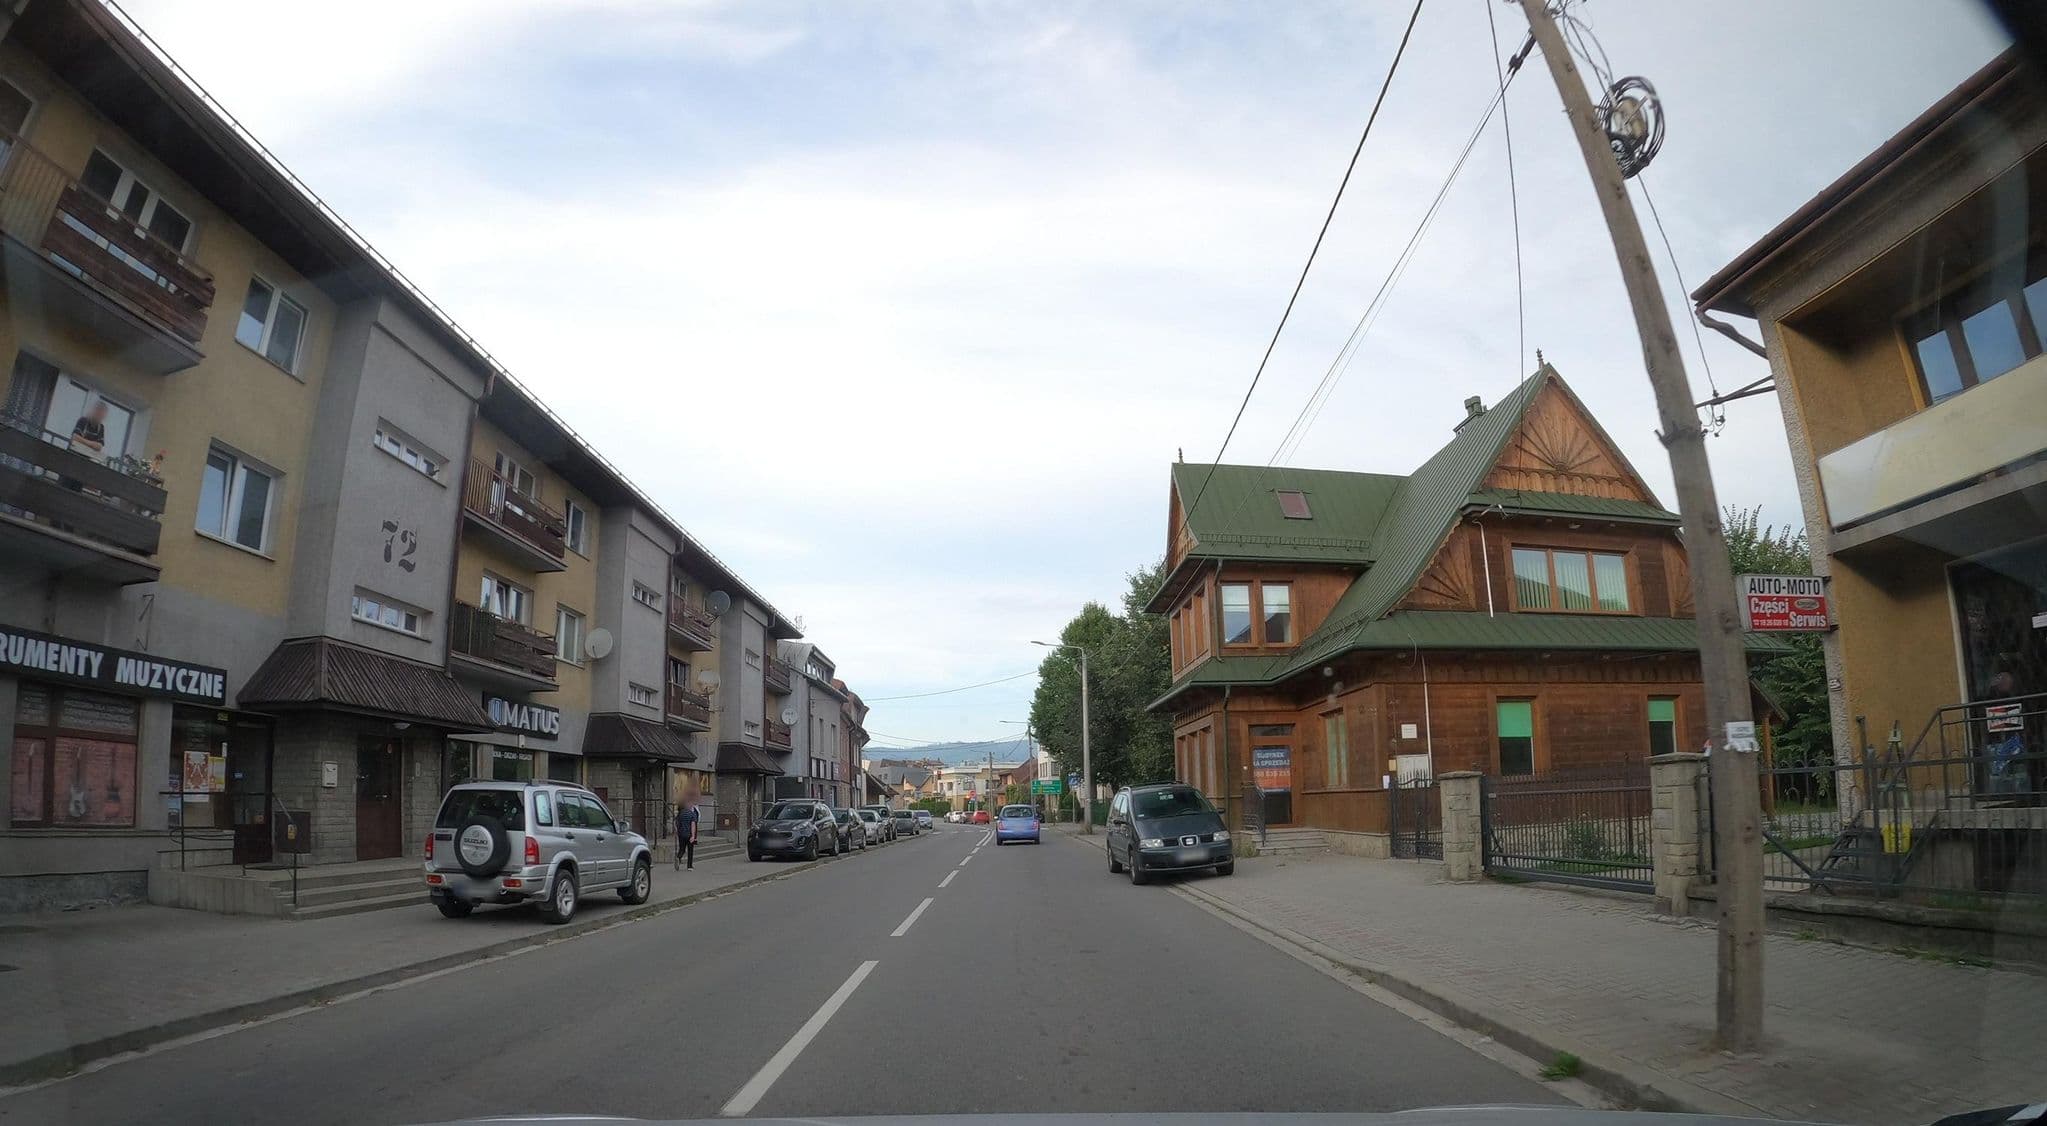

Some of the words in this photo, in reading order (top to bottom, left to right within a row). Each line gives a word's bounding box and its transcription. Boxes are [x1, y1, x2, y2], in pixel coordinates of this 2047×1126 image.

[382, 520, 417, 573] 72
[1749, 578, 1821, 595] AUTO-MOTO
[1751, 597, 1789, 617] Części
[1789, 611, 1826, 628] Serwis
[115, 656, 224, 699] MUZYCZNE
[502, 700, 560, 735] MATUS
